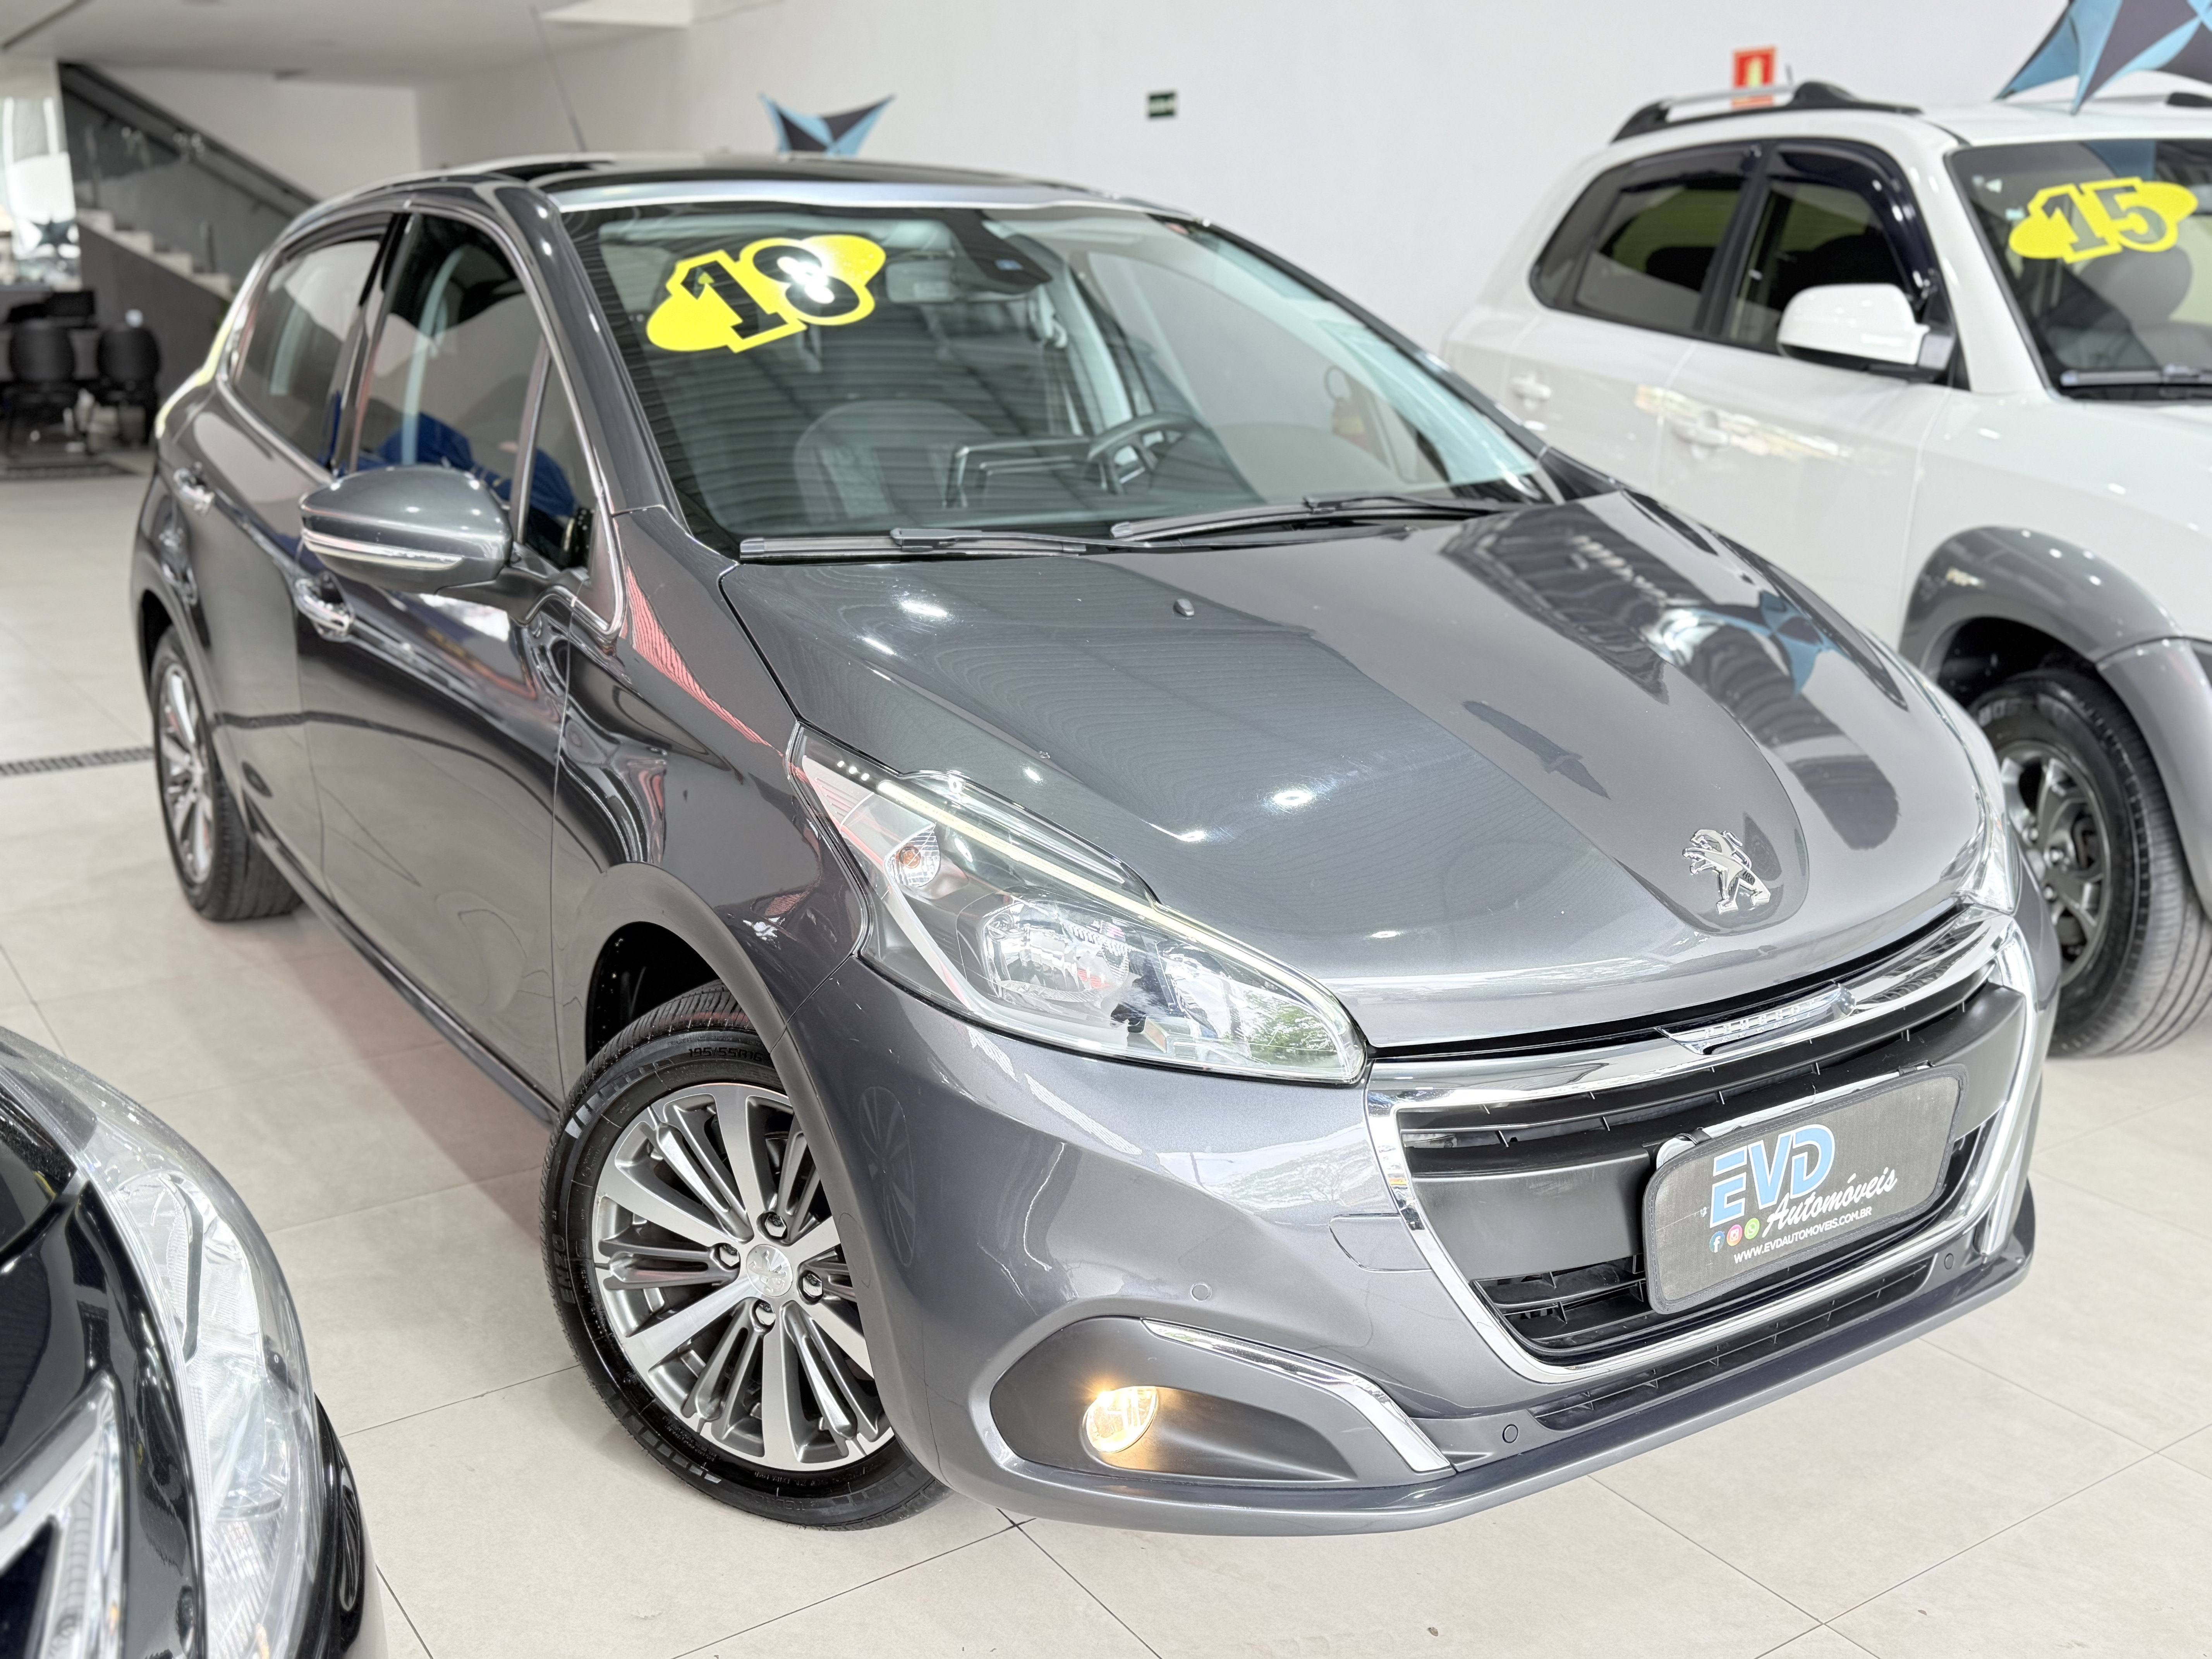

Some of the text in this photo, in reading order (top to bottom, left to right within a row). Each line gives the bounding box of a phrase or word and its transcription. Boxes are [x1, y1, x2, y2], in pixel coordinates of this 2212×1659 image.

[2043, 185, 2167, 252] 15
[680, 244, 860, 338] 18
[688, 1047, 763, 1062] 195/55R16
[1709, 1124, 1836, 1228] EVD
[1762, 1166, 1897, 1238] Automóveis
[552, 1233, 575, 1304] ENZO
[1733, 1205, 1872, 1264] WWW.EVDAUTOMOVEIS.COM.BR
